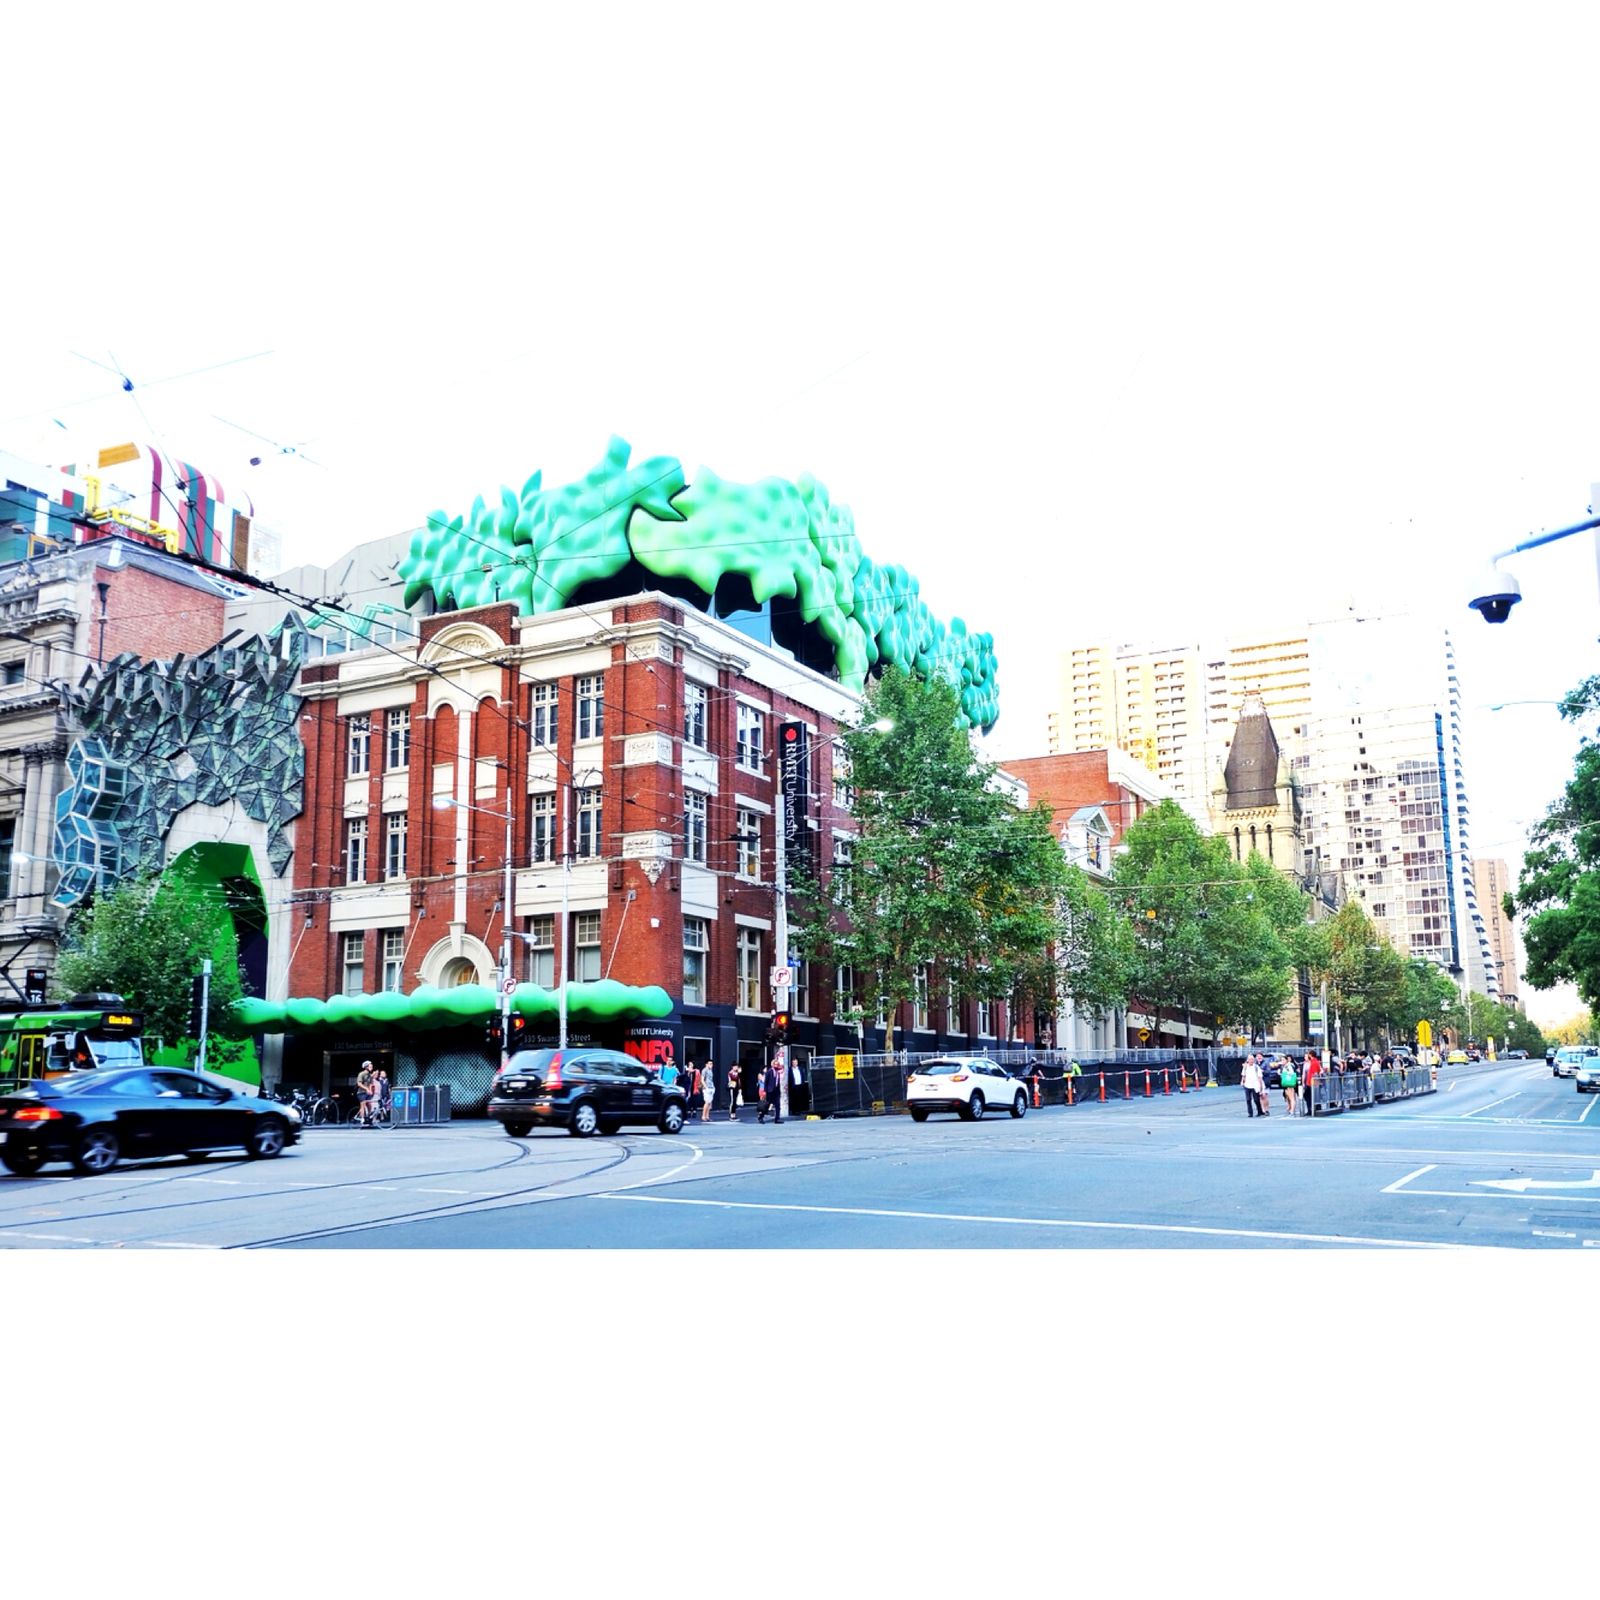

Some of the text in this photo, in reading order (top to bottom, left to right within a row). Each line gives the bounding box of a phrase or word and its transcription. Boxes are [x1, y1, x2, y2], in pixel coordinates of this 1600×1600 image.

[784, 742, 798, 842] RMIT University
[624, 1040, 674, 1063] INFO
